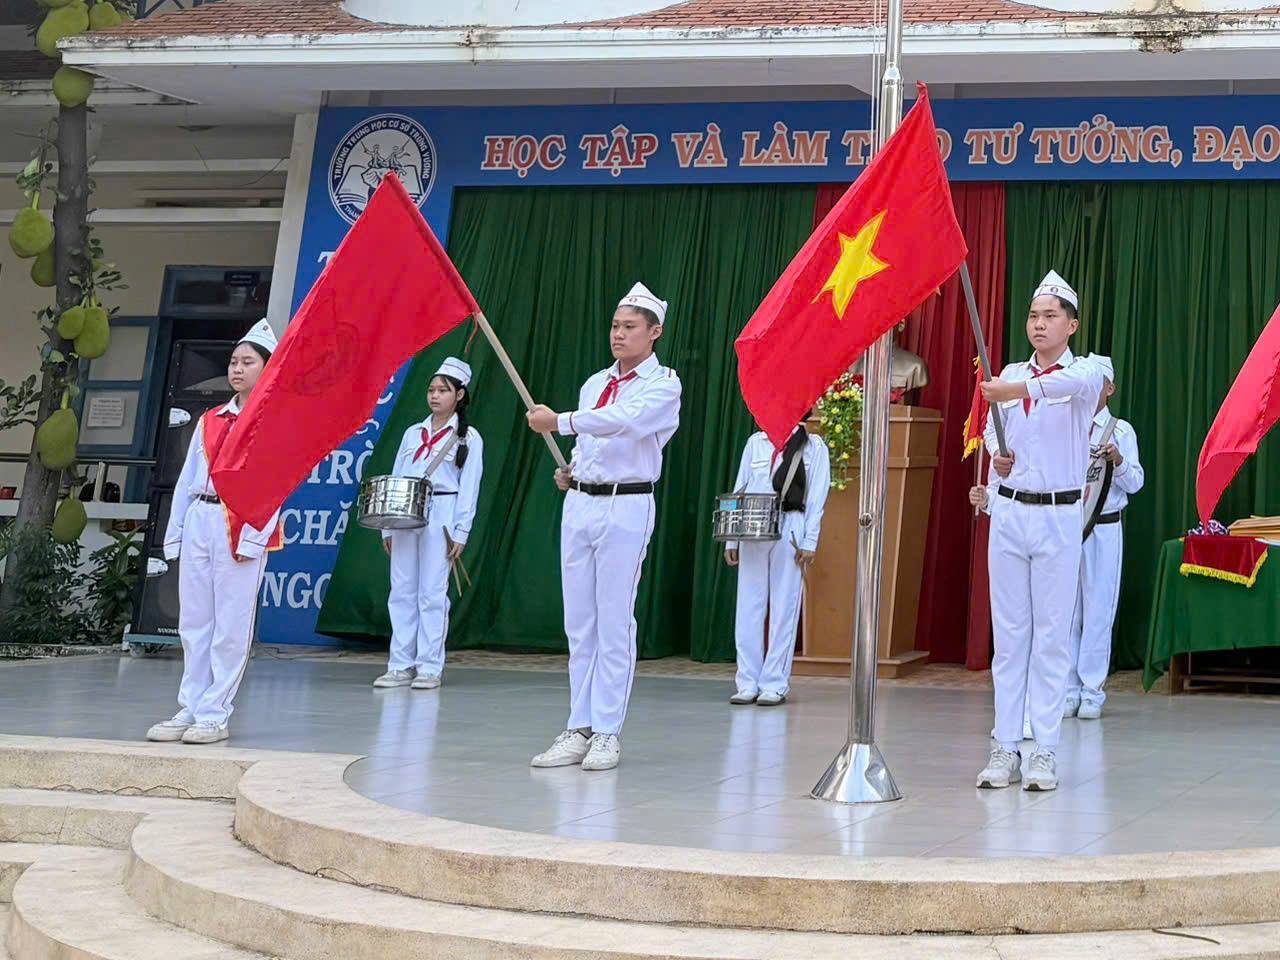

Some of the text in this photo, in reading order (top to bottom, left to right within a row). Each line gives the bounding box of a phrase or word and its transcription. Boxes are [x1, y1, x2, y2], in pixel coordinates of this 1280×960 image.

[481, 134, 567, 177] HỌC
[580, 124, 658, 176] TẬP
[671, 122, 728, 168] VÀ
[739, 121, 831, 167] LÀM
[964, 122, 1024, 165] TƯ
[1029, 114, 1183, 168] TƯỞNG,
[280, 501, 352, 545] CHĂ
